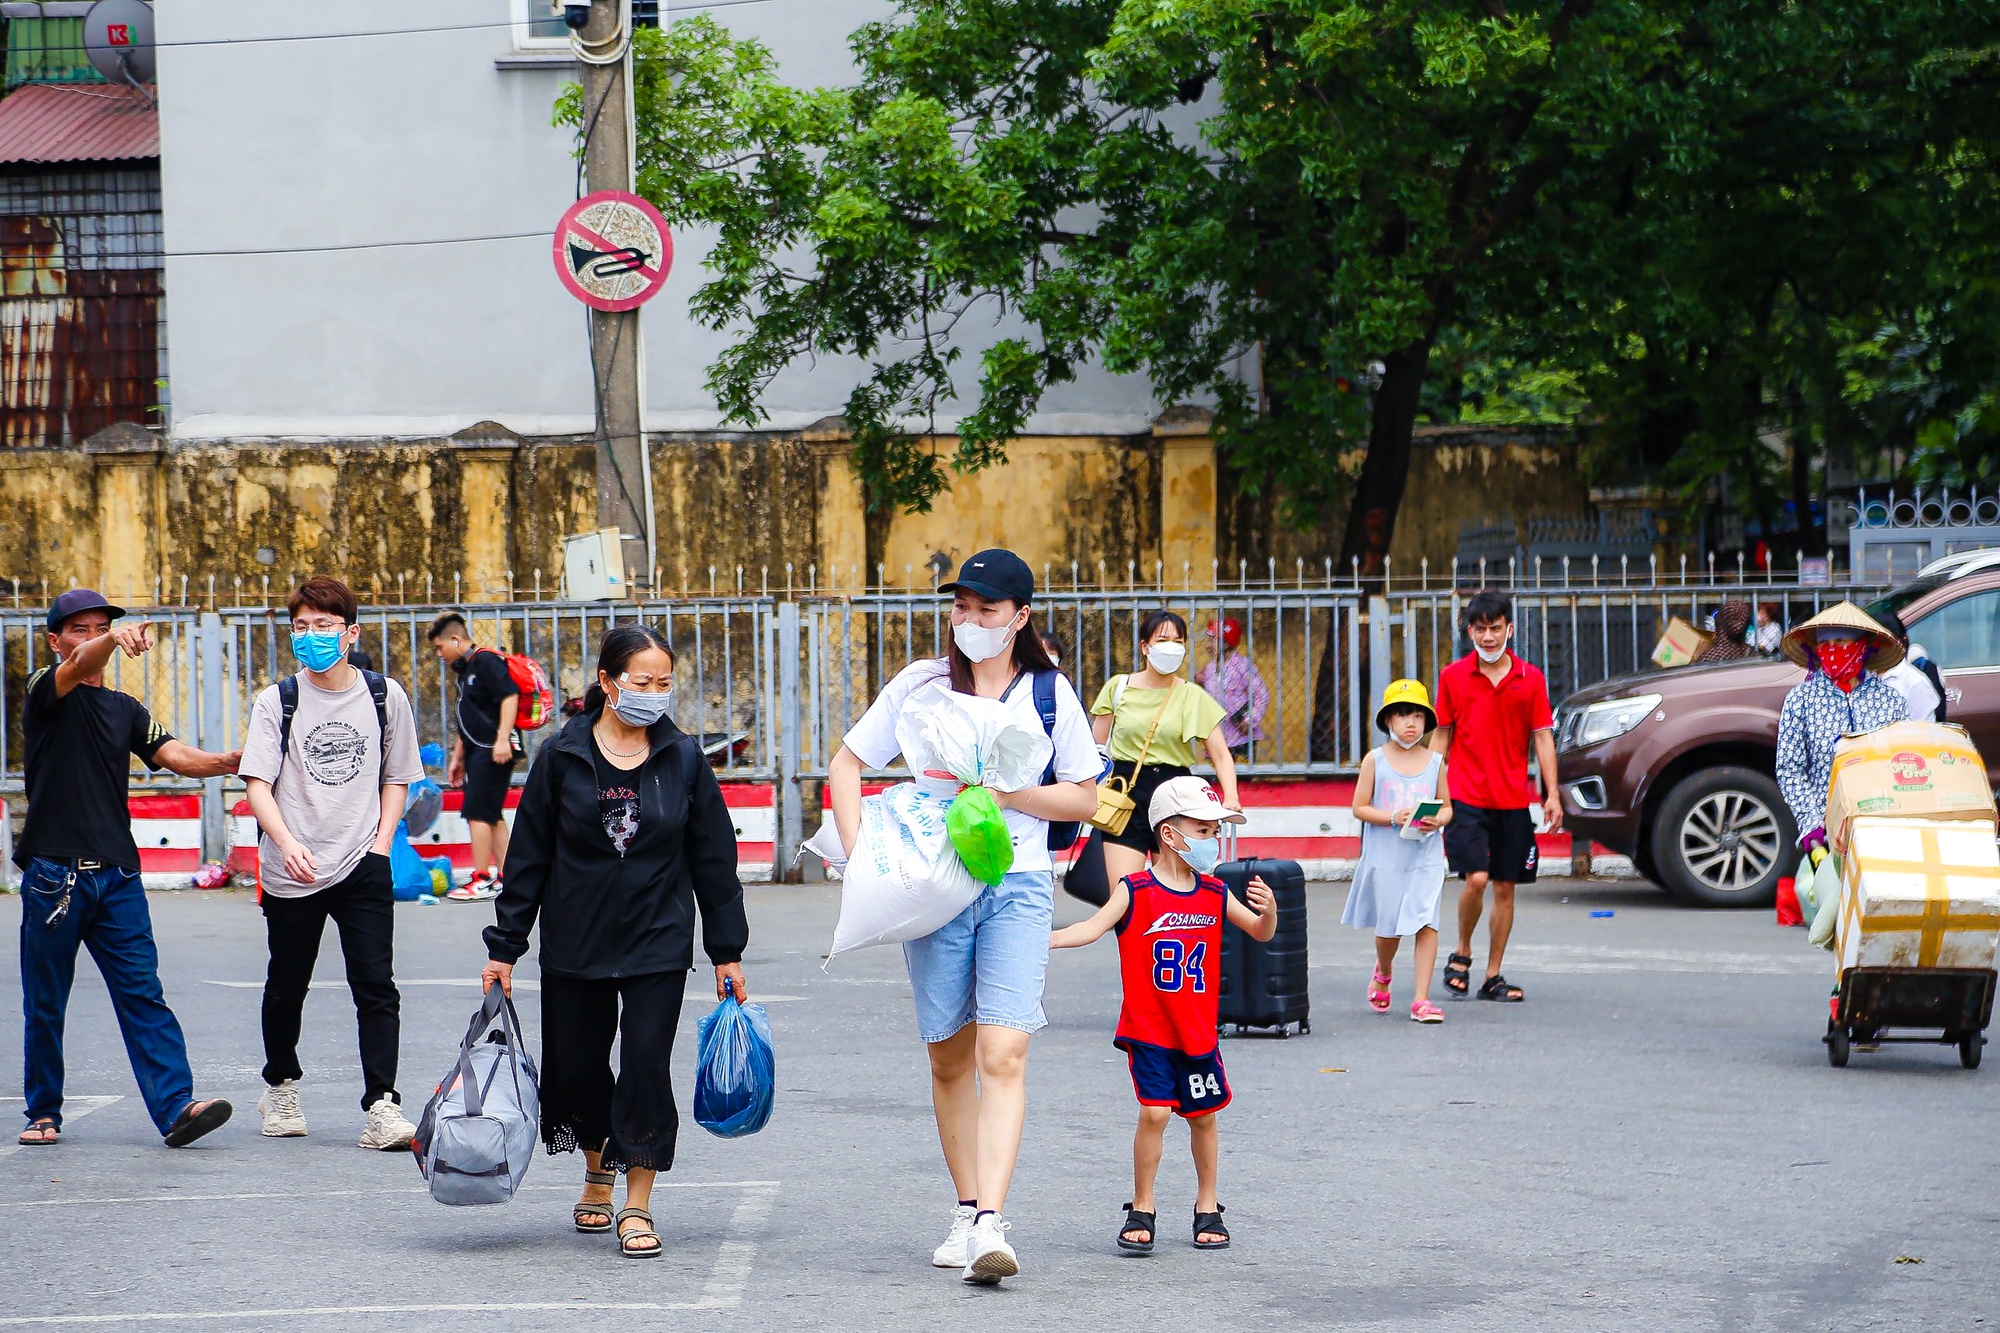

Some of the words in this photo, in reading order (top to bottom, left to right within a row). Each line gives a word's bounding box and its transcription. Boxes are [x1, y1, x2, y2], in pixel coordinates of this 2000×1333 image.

[873, 851, 891, 877] YEAR
[1152, 938, 1207, 993] 84
[1188, 1073, 1222, 1099] 84
